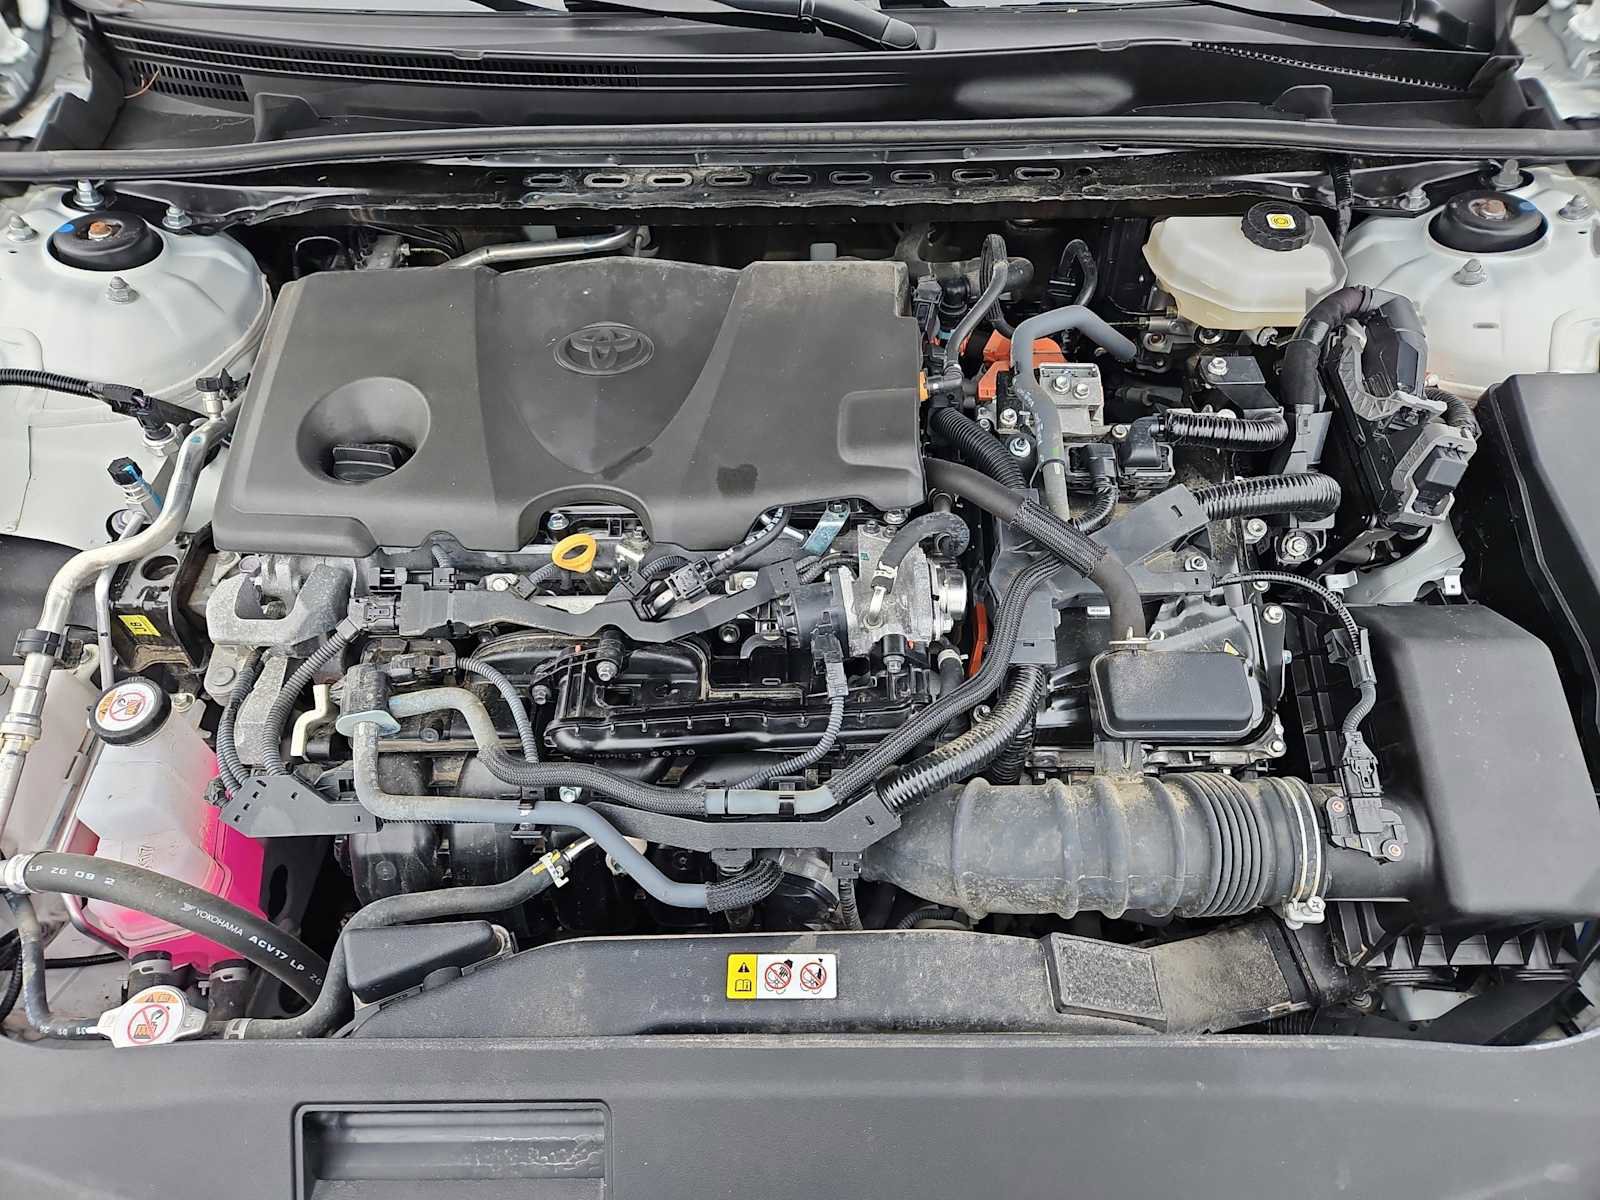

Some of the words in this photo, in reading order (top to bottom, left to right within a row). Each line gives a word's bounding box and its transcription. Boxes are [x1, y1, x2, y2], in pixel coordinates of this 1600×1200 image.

[195, 908, 244, 937] YOKOHAMA
[248, 935, 289, 960] ACV17
[289, 959, 305, 971] LP
